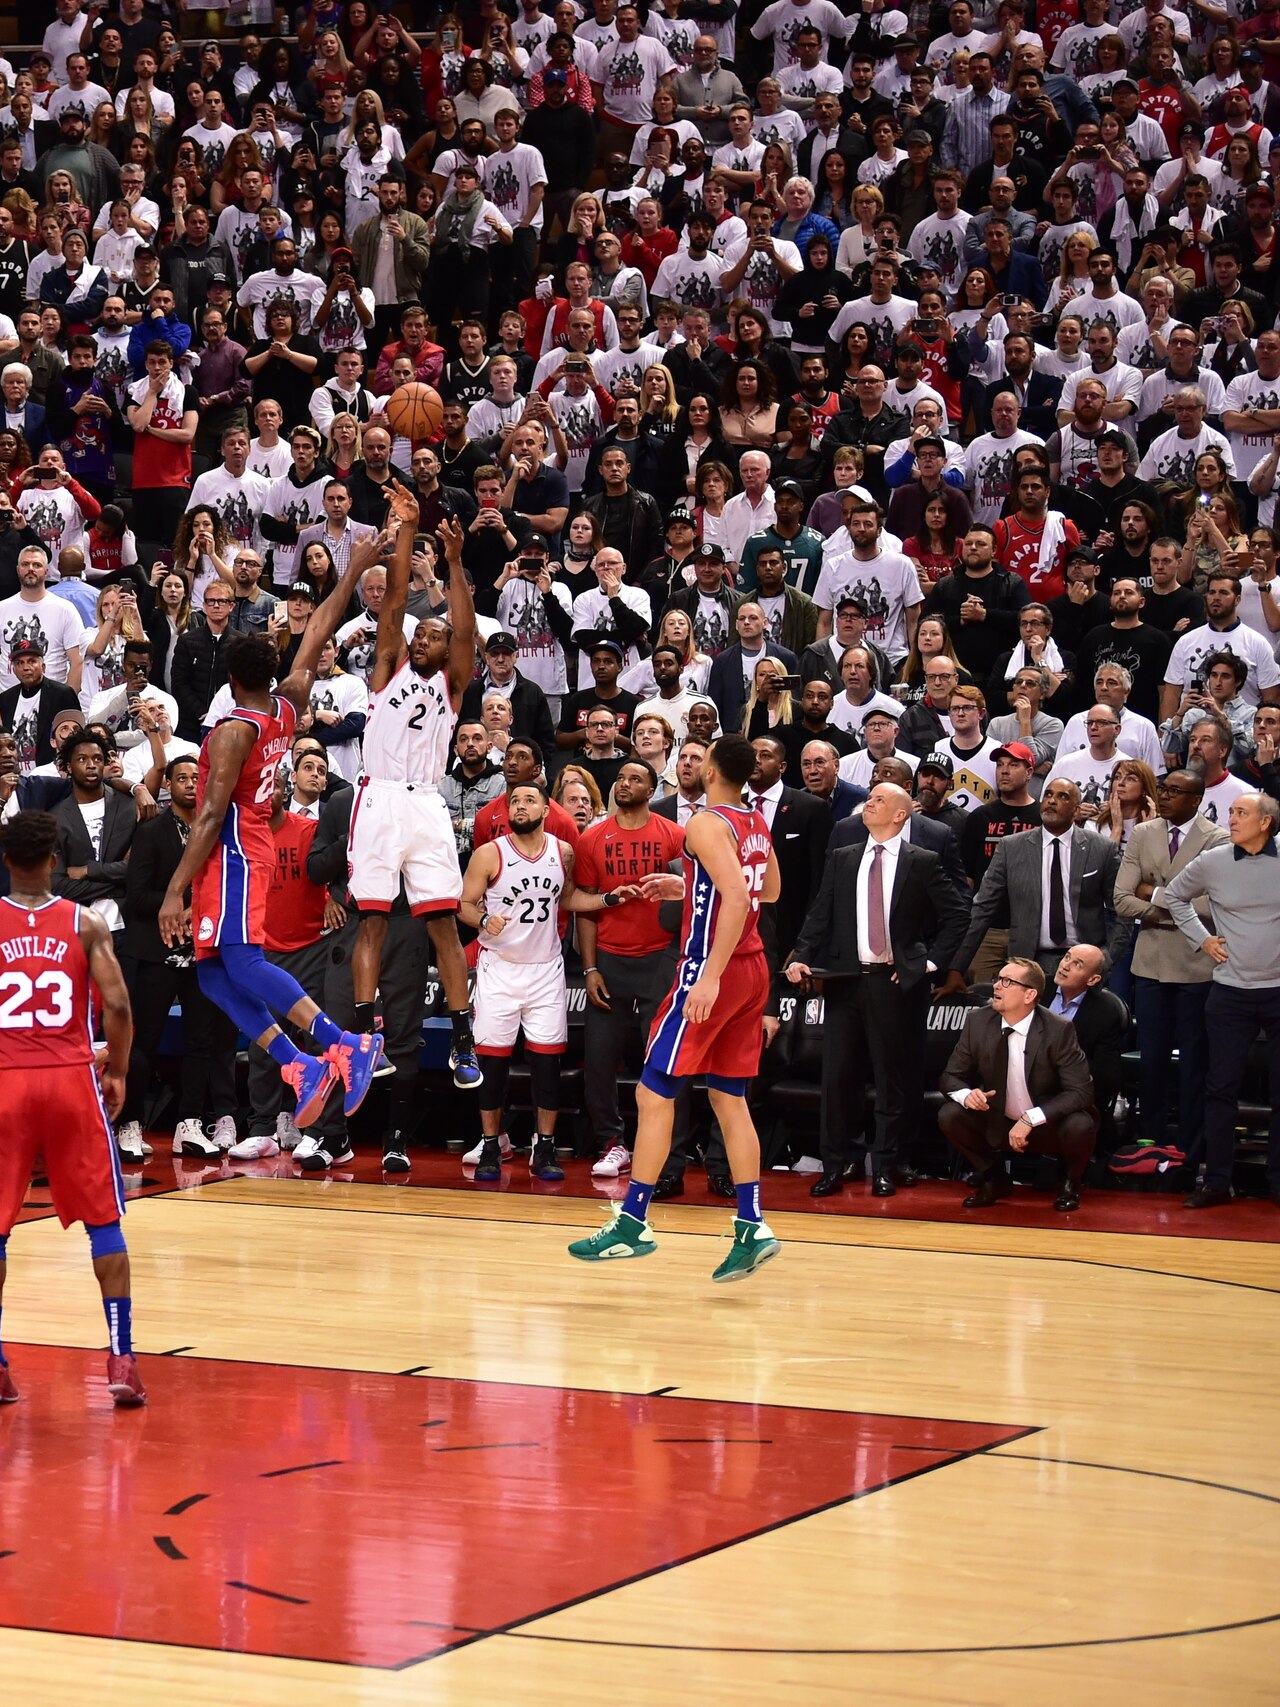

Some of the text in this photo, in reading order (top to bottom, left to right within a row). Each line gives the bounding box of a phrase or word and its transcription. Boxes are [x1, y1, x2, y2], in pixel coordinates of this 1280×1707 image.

[1039, 11, 1076, 29] RAPTORS
[1051, 24, 1062, 43] 2
[1154, 107, 1166, 124] 7
[925, 350, 948, 373] TORS
[457, 385, 485, 402] APTO
[1242, 434, 1276, 448] NORT
[407, 703, 427, 731] 2
[987, 822, 1006, 836] WE
[604, 842, 662, 858] WE THE
[741, 834, 772, 863] SIMMONS
[605, 859, 663, 877] NORTH
[519, 896, 551, 924] 23
